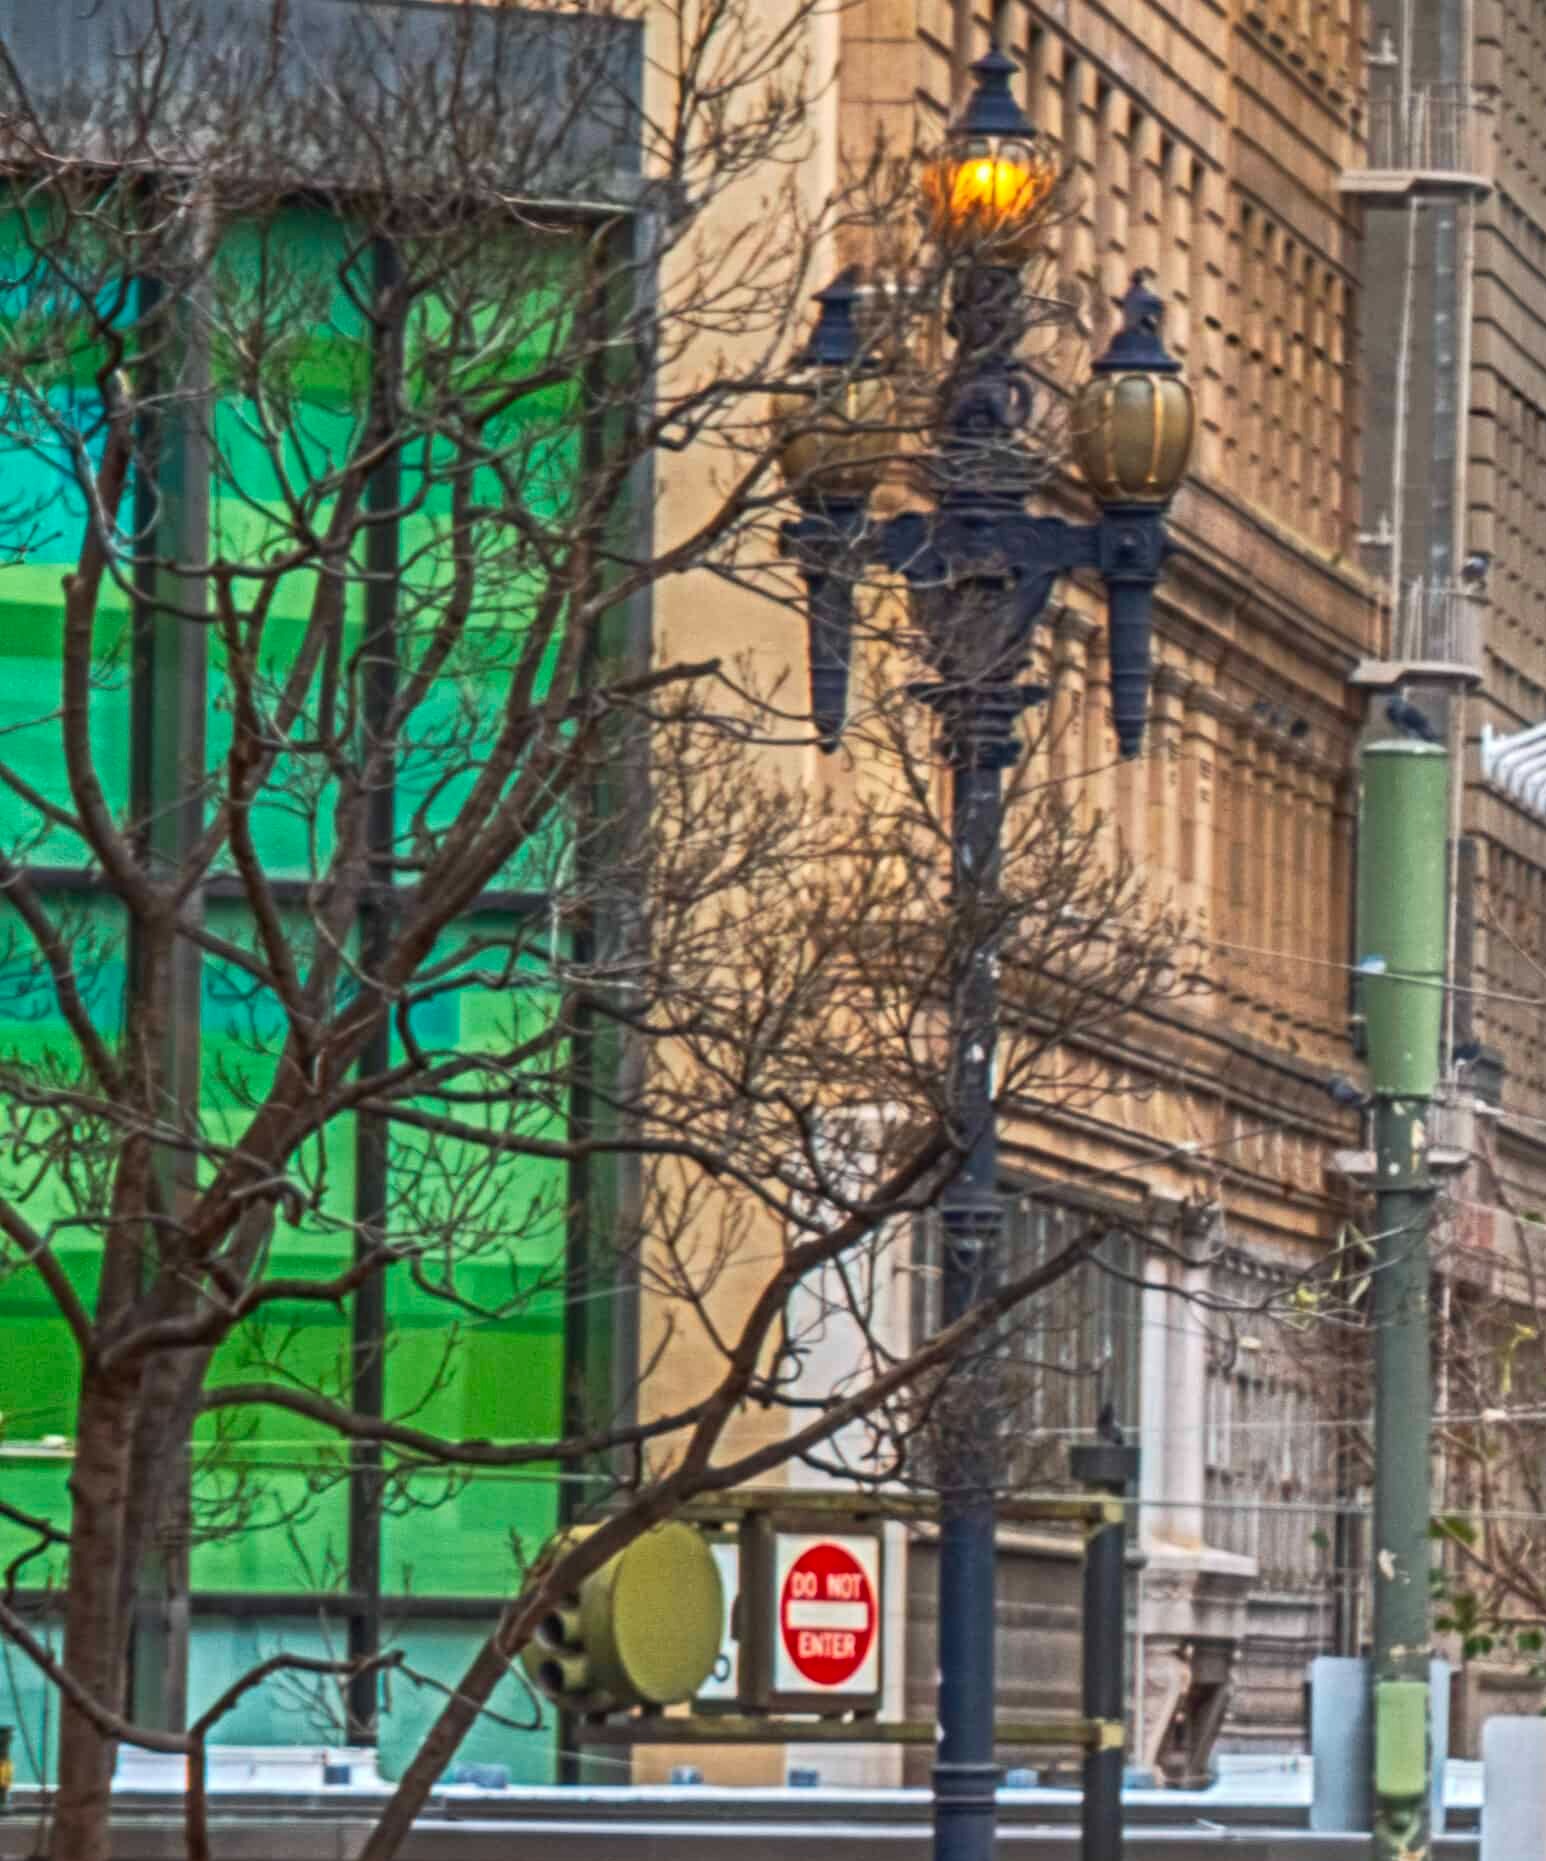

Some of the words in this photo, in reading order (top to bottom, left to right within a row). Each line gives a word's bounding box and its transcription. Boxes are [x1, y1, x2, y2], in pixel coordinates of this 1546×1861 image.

[790, 1571, 818, 1598] DO
[826, 1572, 863, 1599] NOT
[797, 1631, 857, 1659] ENTER
